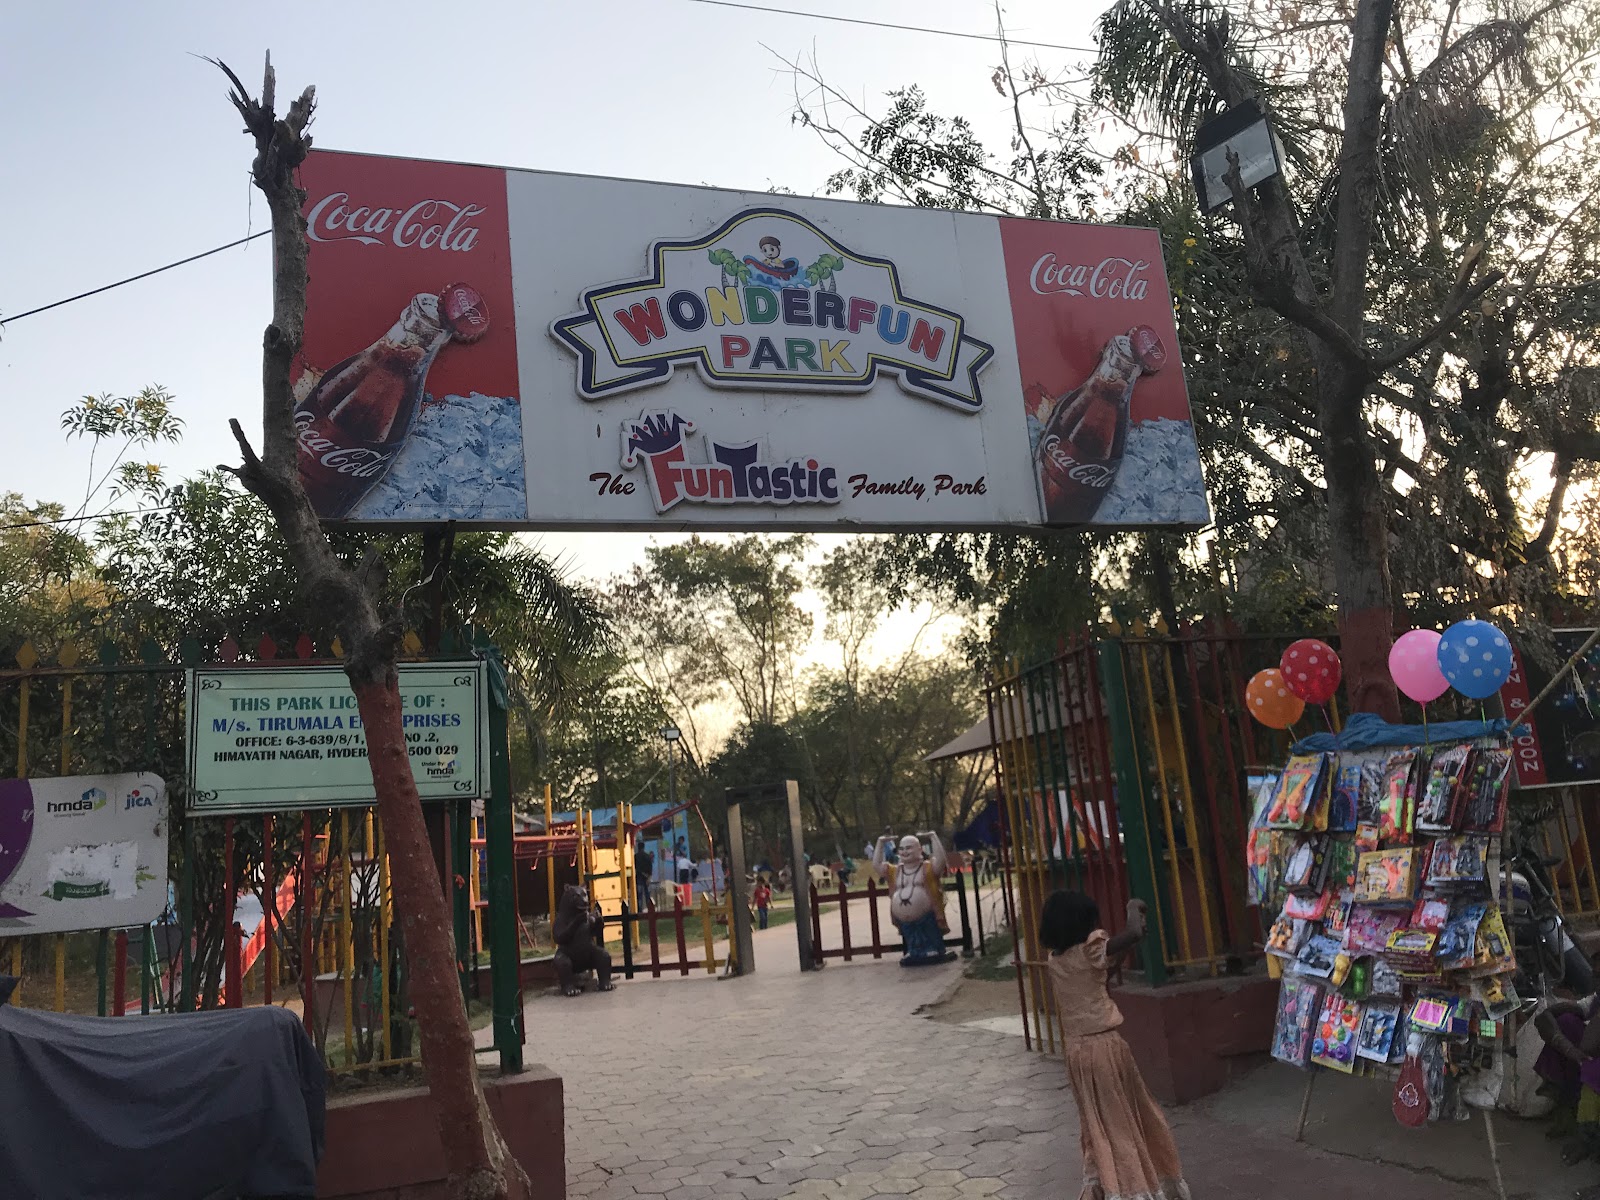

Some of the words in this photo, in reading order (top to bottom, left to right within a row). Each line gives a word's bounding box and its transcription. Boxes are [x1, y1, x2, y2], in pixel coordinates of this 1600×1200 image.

[306, 192, 487, 252] Coca-Cola
[1029, 252, 1151, 301] Coca-Cola
[613, 286, 946, 363] WONDERFUN
[720, 334, 857, 373] PARK
[589, 472, 636, 495] The
[649, 441, 840, 507] FunTastic
[847, 474, 926, 499] Family
[934, 474, 988, 496] Park
[229, 697, 271, 712] THIS
[276, 696, 324, 711] PARK
[413, 694, 435, 708] OF
[212, 717, 251, 735] M/s.
[257, 714, 344, 731] TIRUMALA
[235, 736, 282, 747] OFFICE:
[285, 733, 365, 747] 6-3-639/8/1,
[213, 750, 276, 762] HIMAYATH
[279, 748, 323, 761] NAGAR,
[408, 746, 431, 757] 500
[435, 745, 459, 756] 029
[427, 767, 454, 776] hmda
[47, 798, 93, 812] hmda
